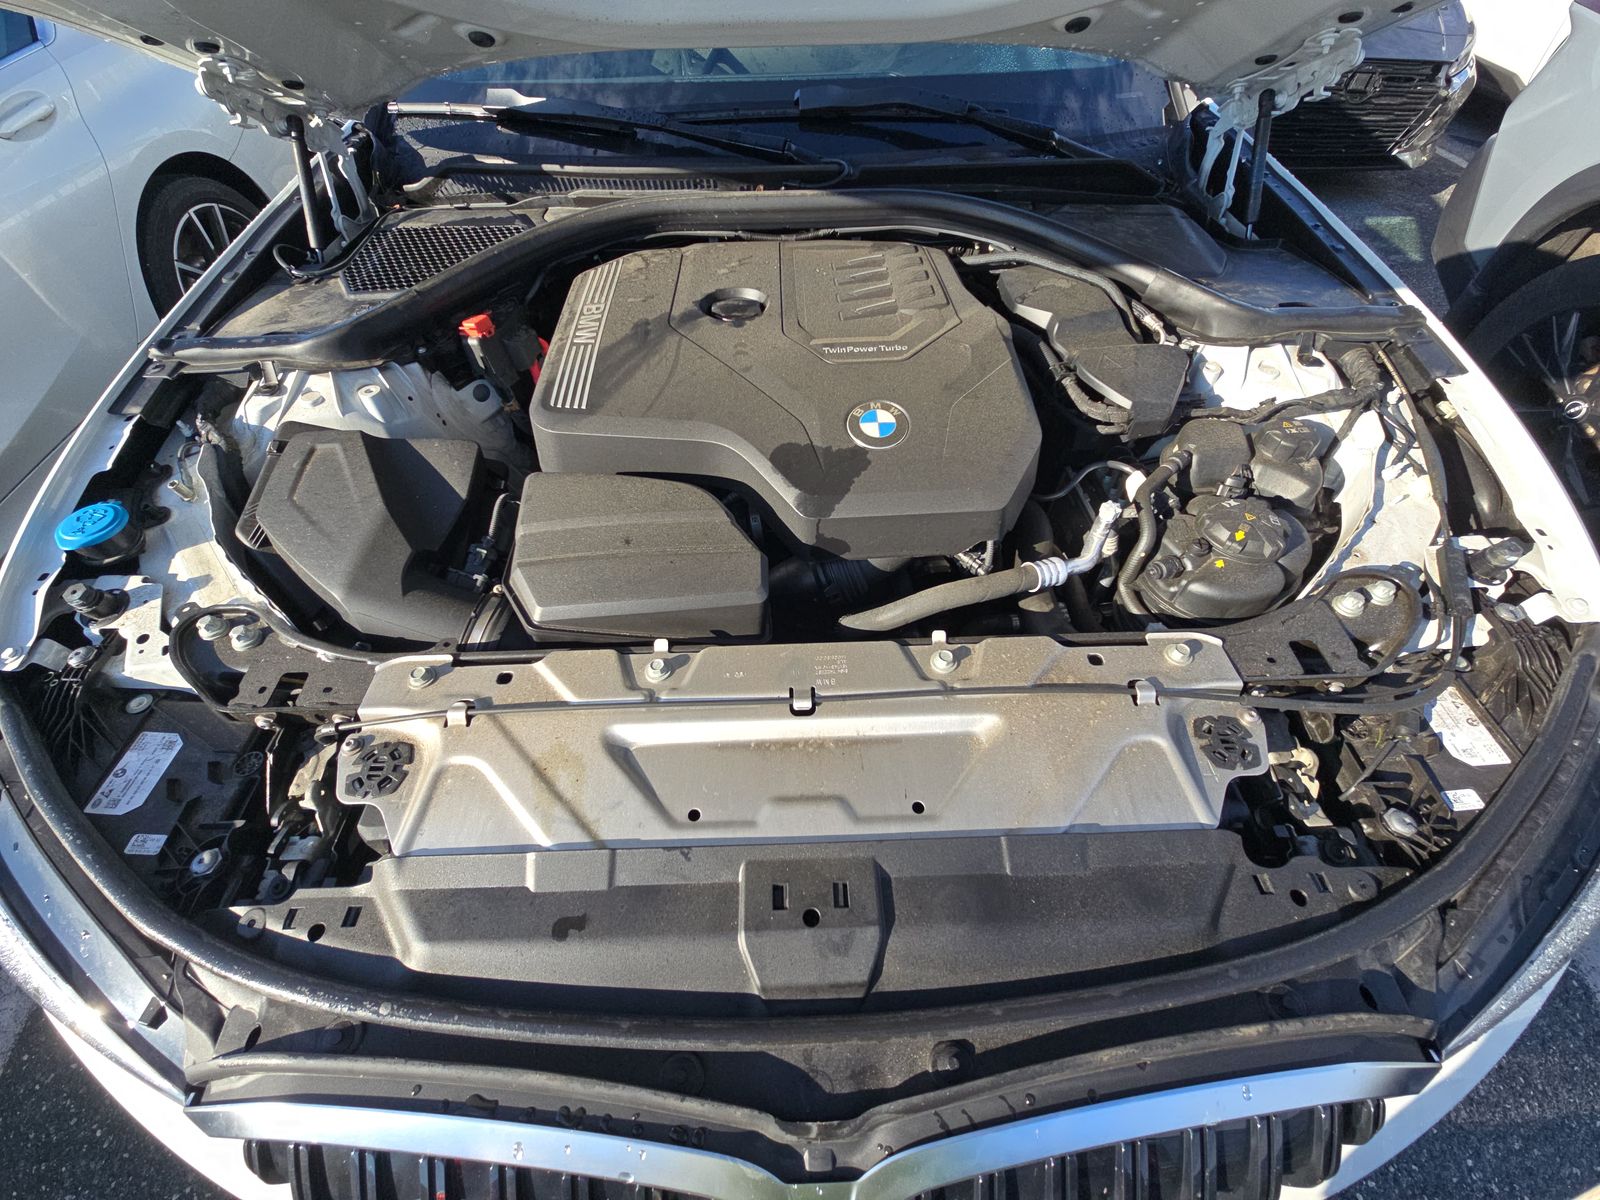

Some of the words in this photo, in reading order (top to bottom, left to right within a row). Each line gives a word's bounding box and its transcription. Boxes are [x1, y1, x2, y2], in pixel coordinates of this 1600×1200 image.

[573, 303, 605, 343] BMW
[822, 345, 877, 354] TwinPower
[879, 344, 908, 352] Turbo
[852, 402, 901, 417] BMW
